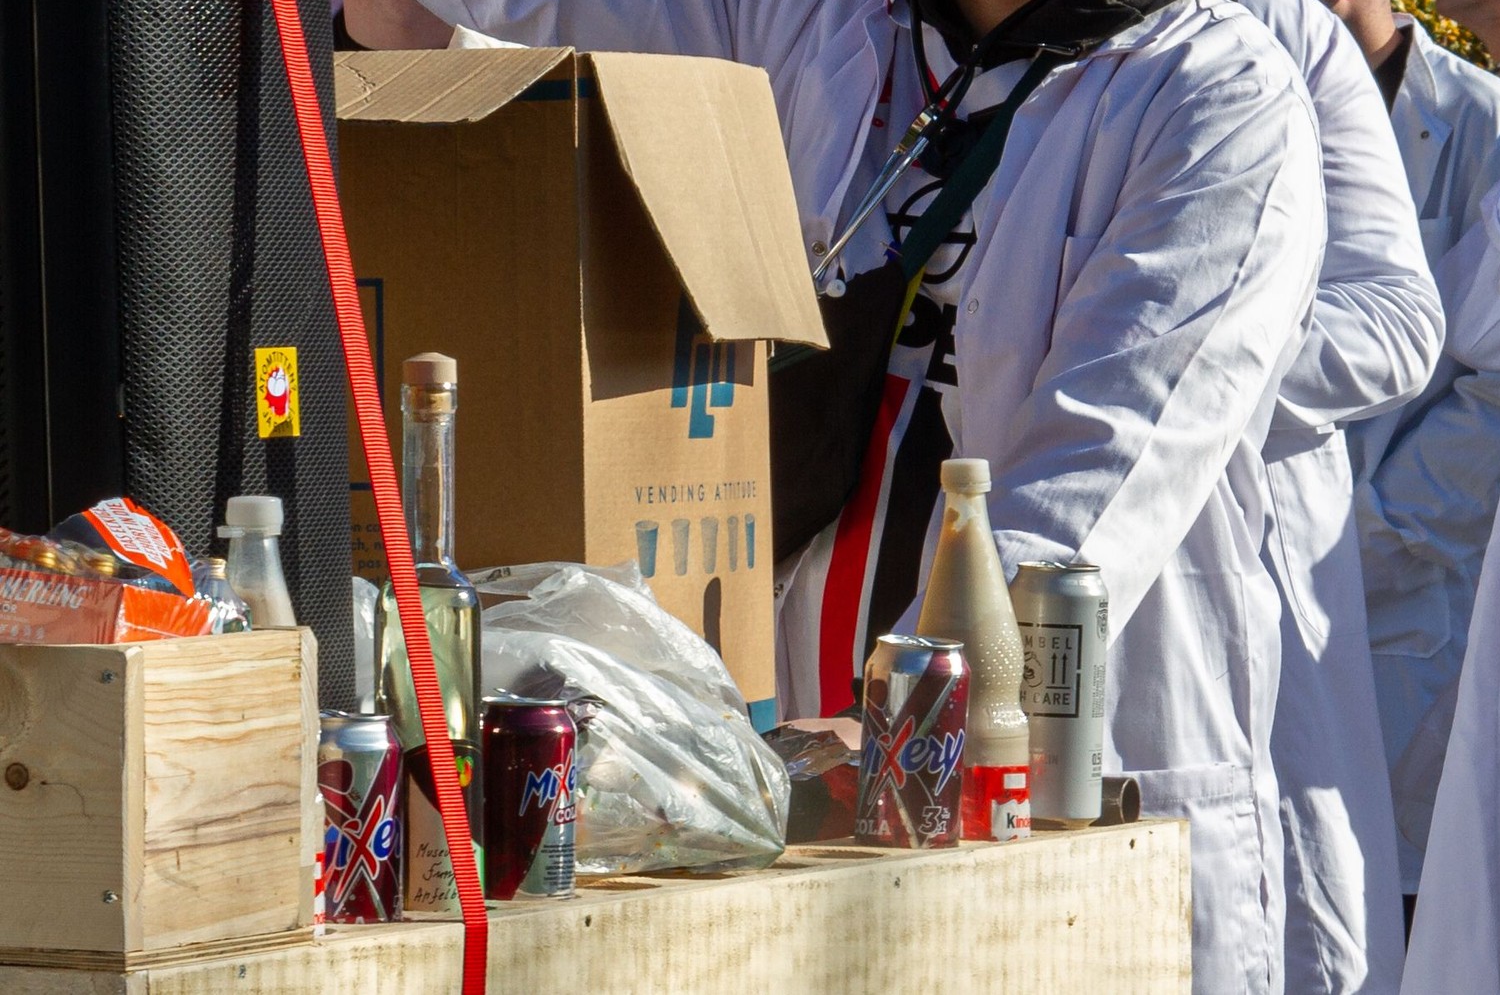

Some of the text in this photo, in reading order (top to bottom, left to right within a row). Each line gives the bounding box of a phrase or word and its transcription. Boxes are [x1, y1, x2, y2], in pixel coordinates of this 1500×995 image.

[634, 480, 757, 504] VENDING ATTITUDE
[0, 574, 85, 610] MERLING
[1024, 636, 1073, 651] MBEL
[1032, 692, 1071, 706] CARE
